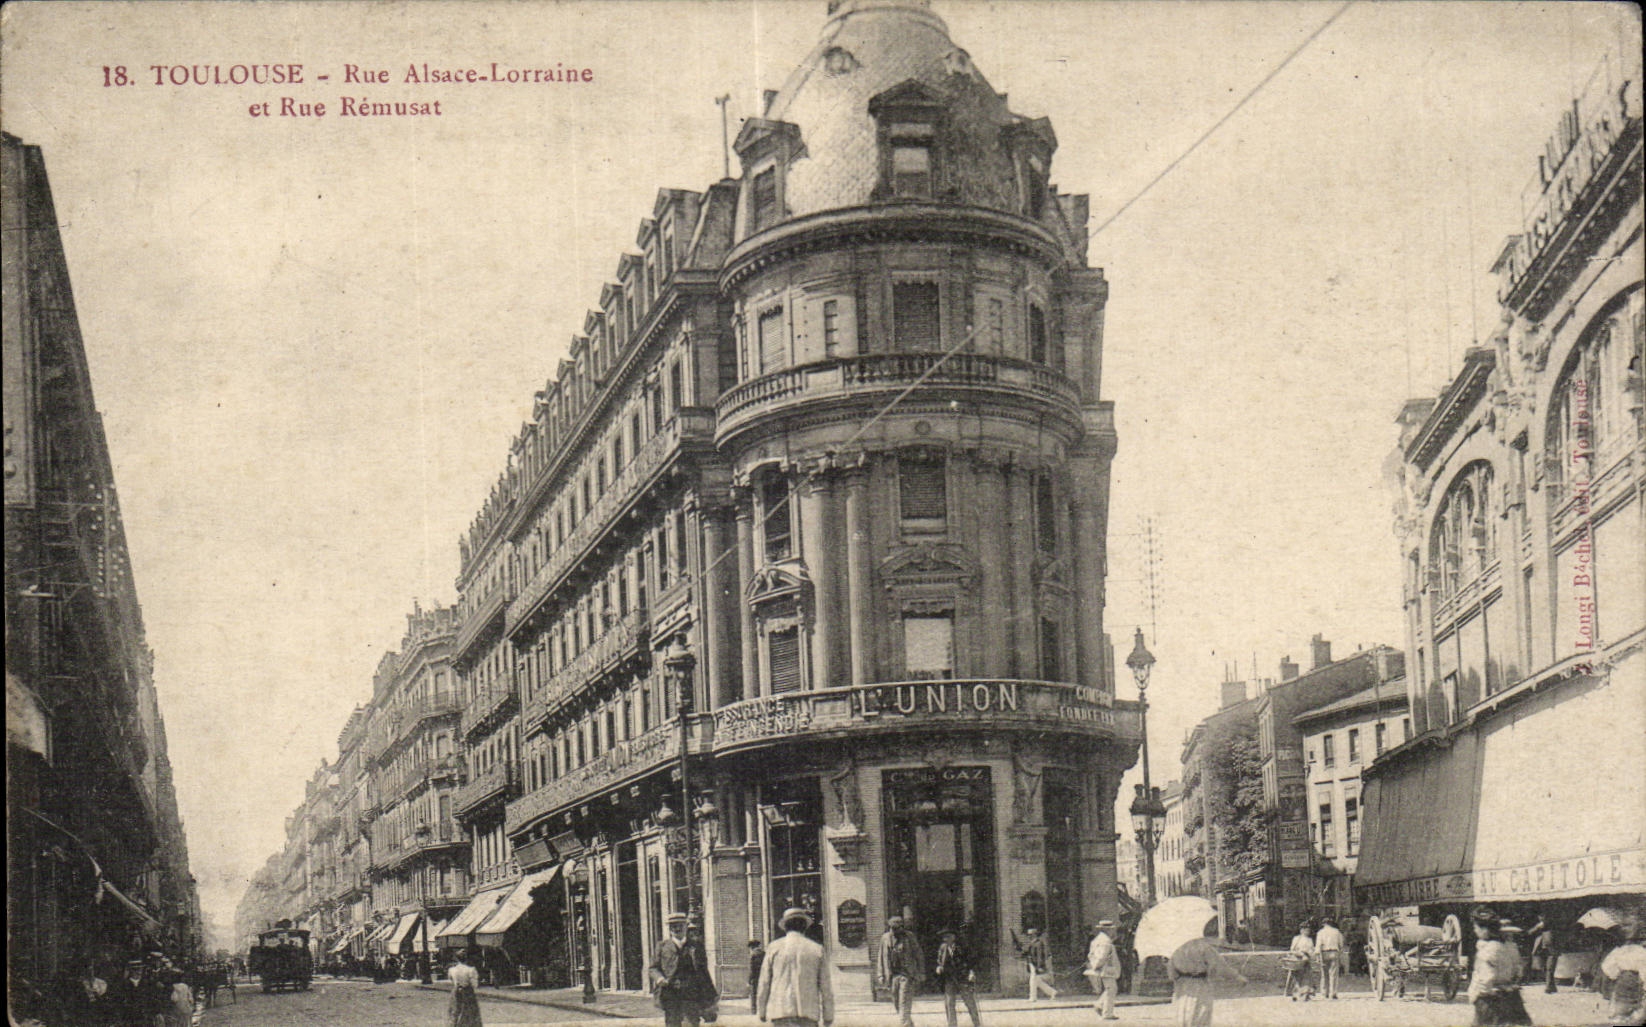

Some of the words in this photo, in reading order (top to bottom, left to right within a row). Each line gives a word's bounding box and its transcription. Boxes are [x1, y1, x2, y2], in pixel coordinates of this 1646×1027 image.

[860, 682, 1018, 717] L'UNION
[942, 768, 985, 781] GAZ
[1480, 871, 1497, 894] AU
[1510, 854, 1622, 893] CAPITOLE
